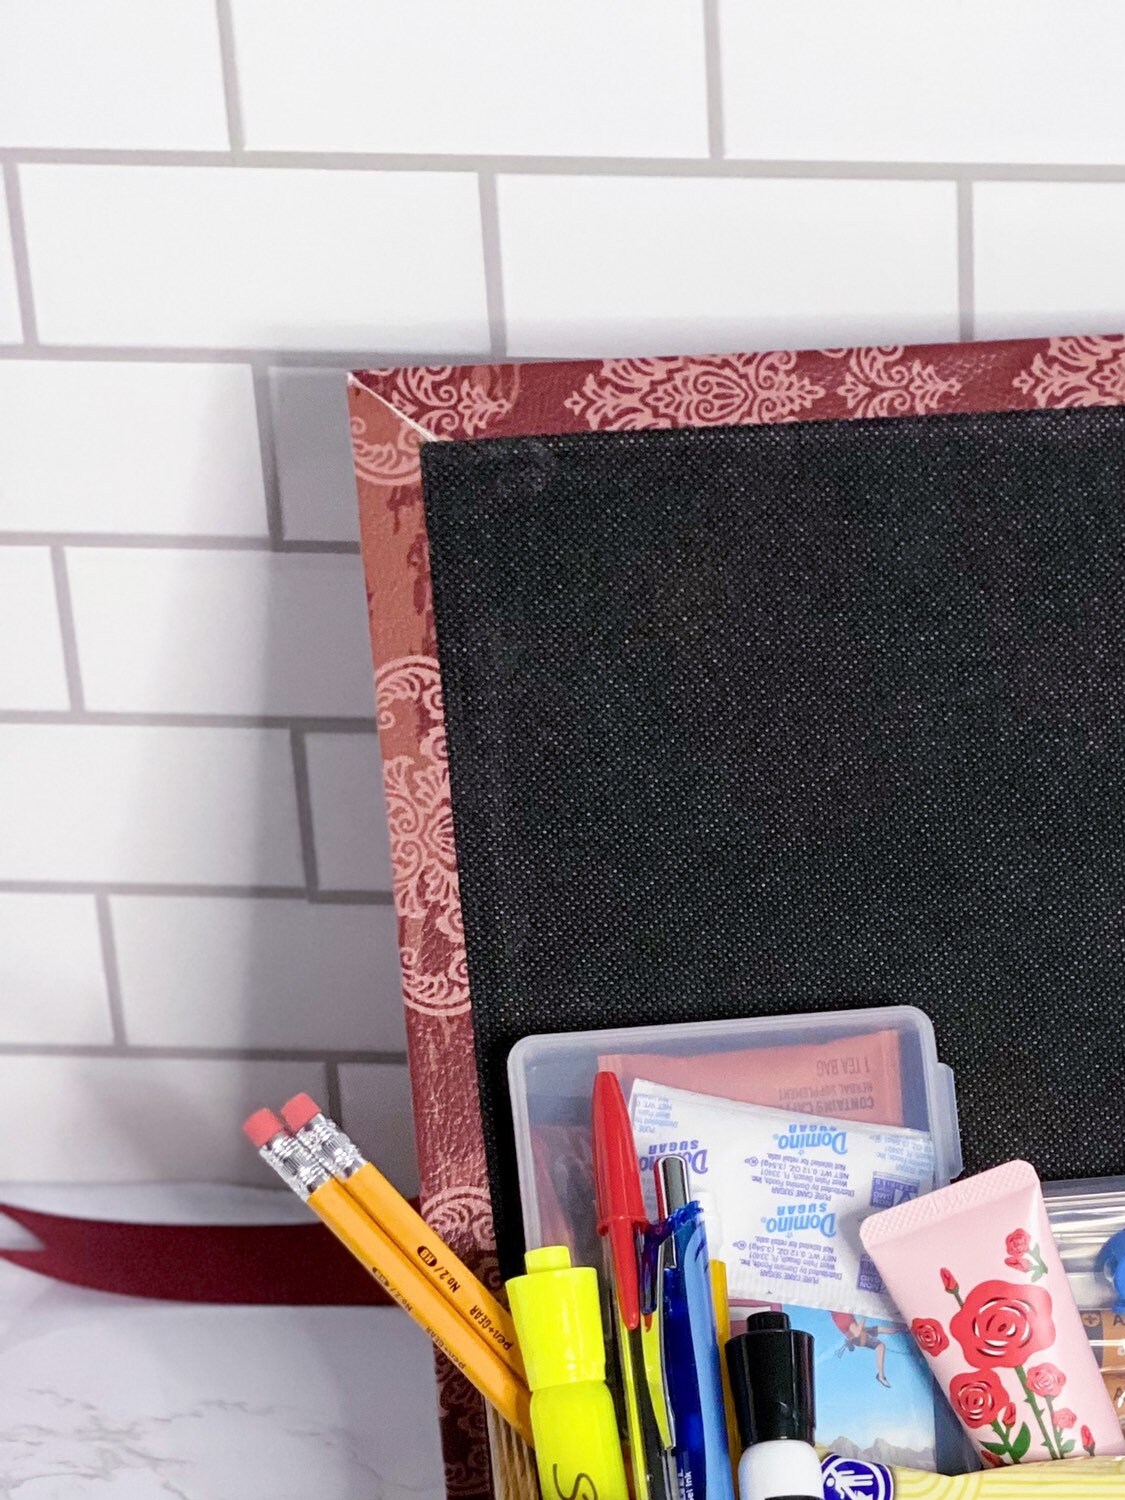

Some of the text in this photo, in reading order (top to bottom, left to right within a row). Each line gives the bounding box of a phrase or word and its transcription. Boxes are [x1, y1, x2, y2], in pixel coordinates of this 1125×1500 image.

[816, 1058, 838, 1077] BAG
[841, 1057, 860, 1075] TEA
[815, 1095, 874, 1113] CONTAINS
[648, 1140, 697, 1154] SUGAR
[777, 1132, 847, 1155] Domino
[777, 1203, 826, 1215] SUGAR
[765, 1213, 835, 1237] Domino
[470, 1304, 514, 1351] pen+GEAR
[684, 1471, 692, 1486] Ink
